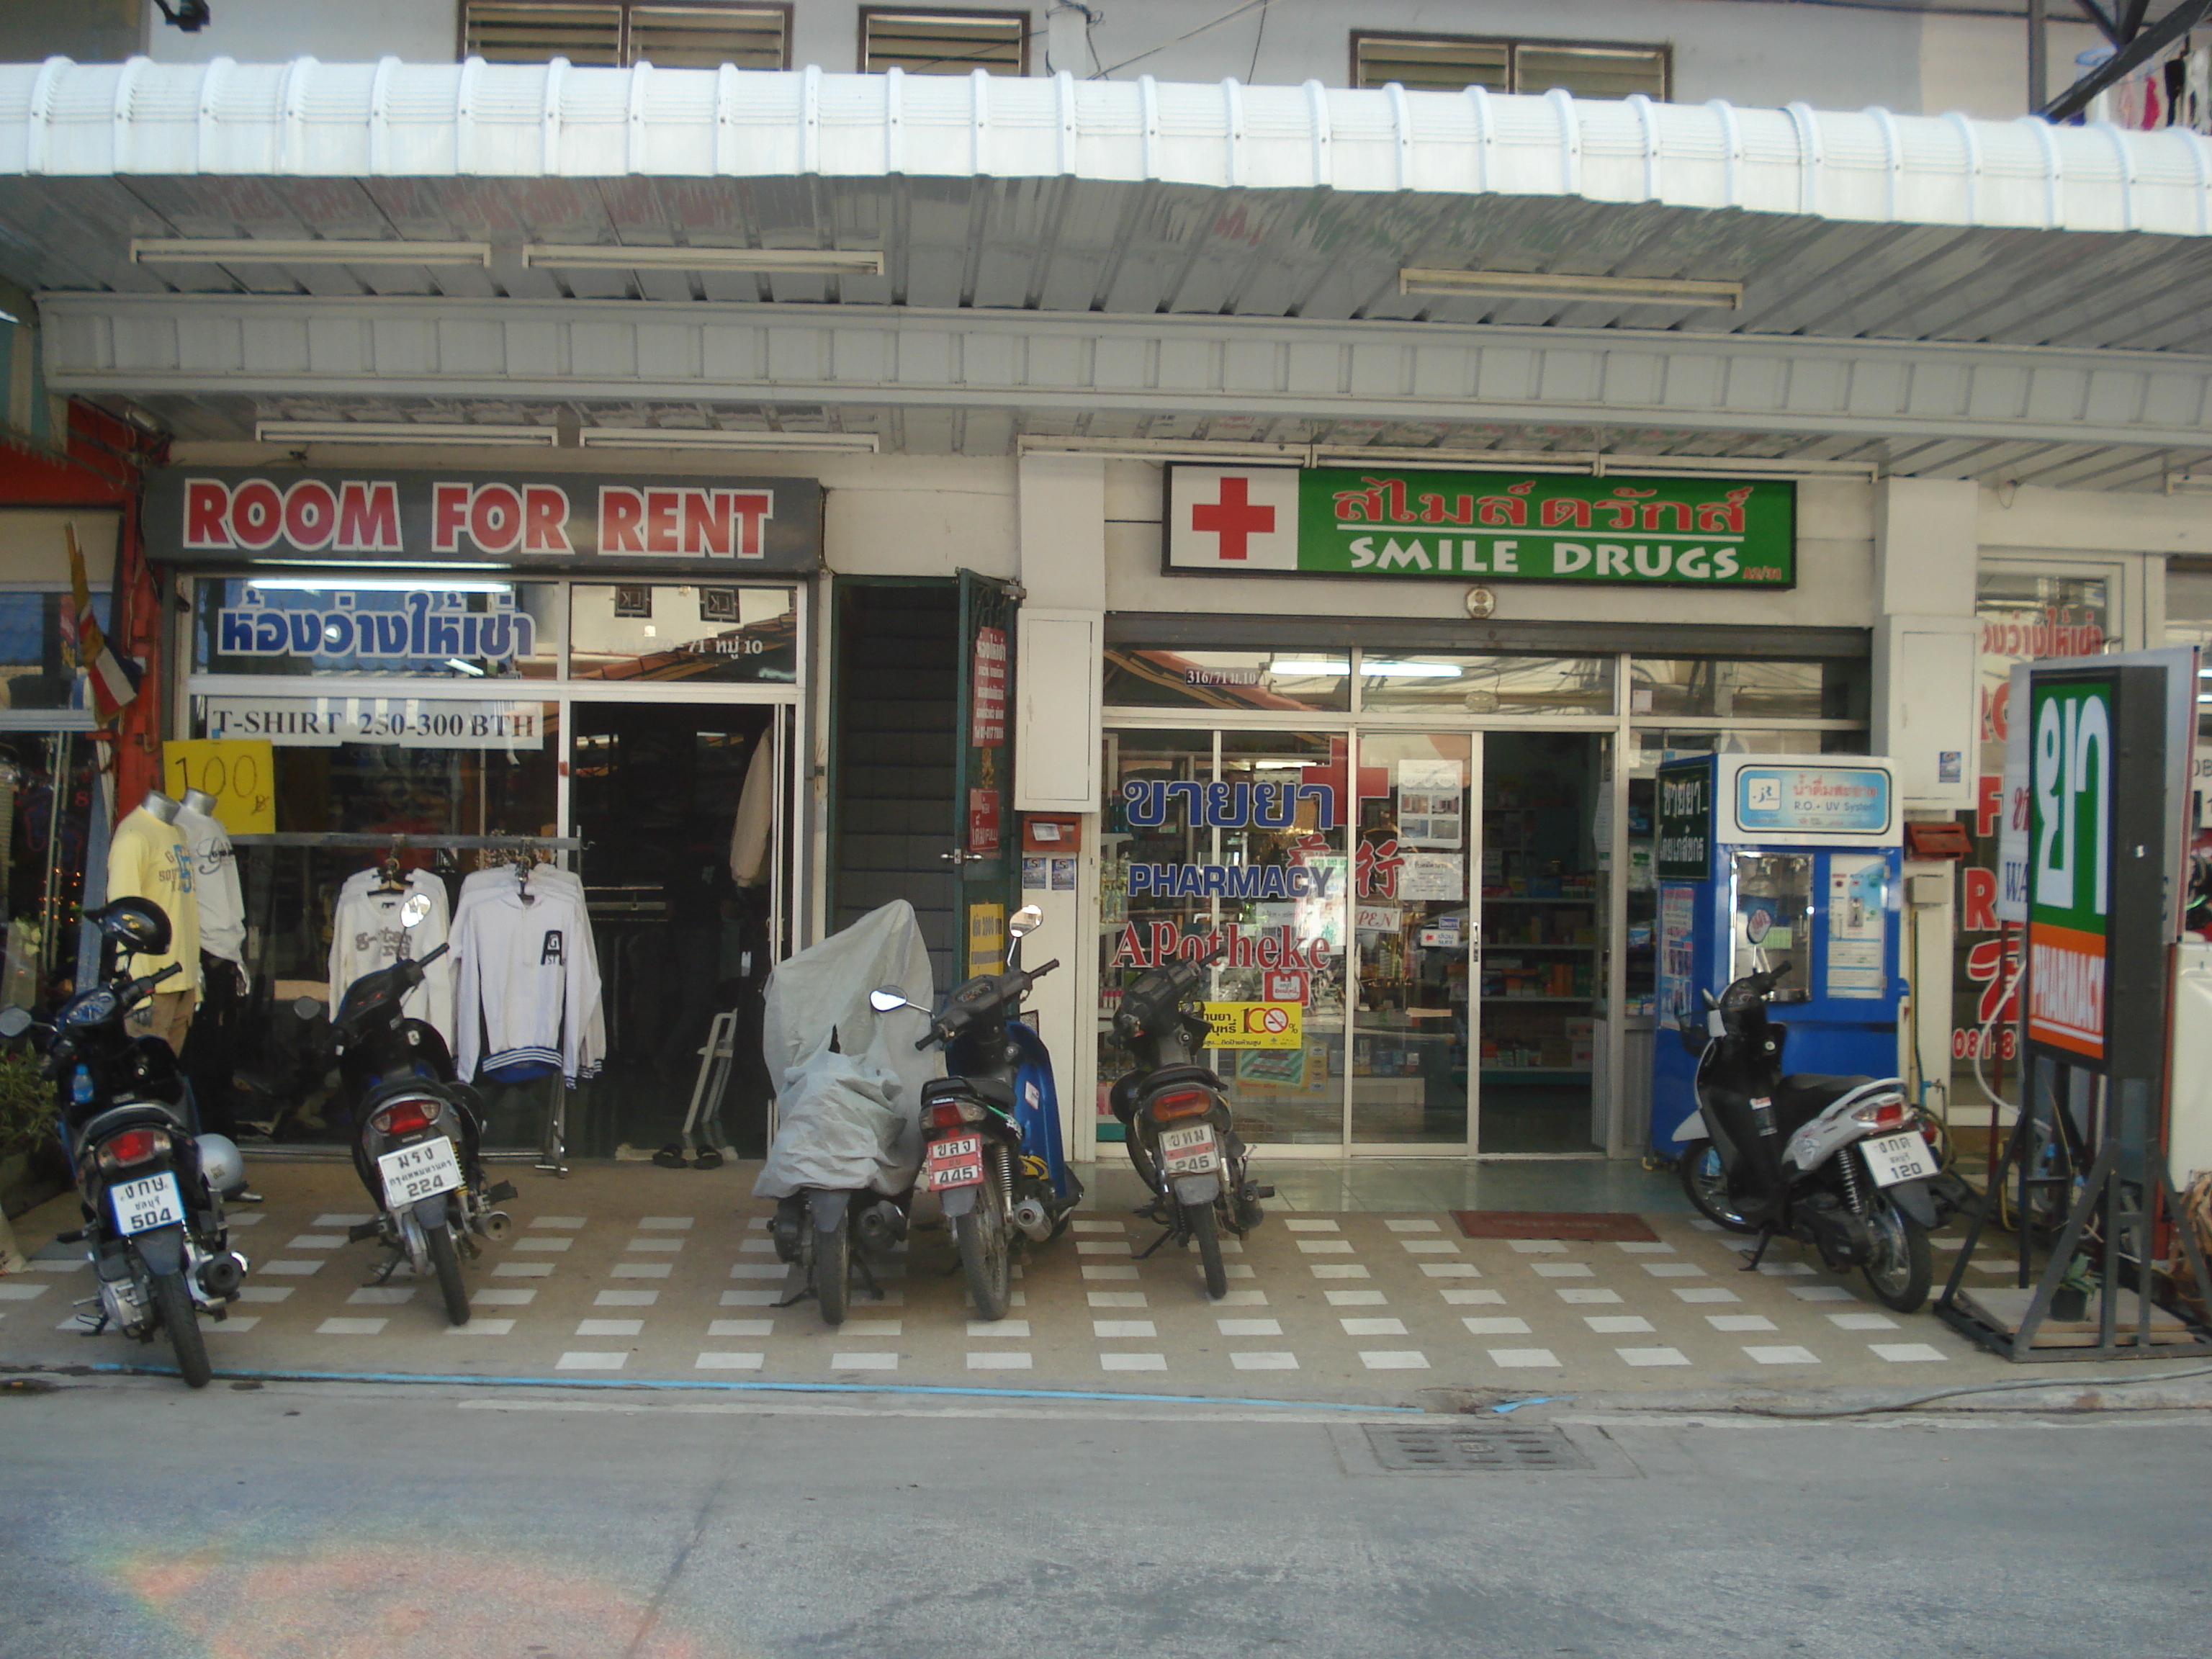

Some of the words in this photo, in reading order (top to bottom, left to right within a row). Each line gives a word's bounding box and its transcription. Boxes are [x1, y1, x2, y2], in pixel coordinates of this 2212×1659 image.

[183, 478, 403, 552] ROOM
[432, 482, 575, 554] FOR
[598, 485, 774, 559] RENT
[1349, 536, 1519, 573] SMILE
[1553, 541, 1740, 579] DRUGS
[217, 586, 536, 658] ห้องว่างให้เช่า
[744, 639, 763, 654] 10
[1187, 670, 1226, 684] 316/71
[213, 709, 342, 735] T-SHIRT
[359, 713, 463, 738] 250-300
[470, 714, 534, 738] BTH
[175, 755, 257, 798] 100
[1123, 781, 1335, 830] ขายยา
[1826, 801, 1840, 811] UV
[2036, 693, 2110, 916] ยา
[1128, 863, 1334, 899] PHARMACY
[1356, 908, 1398, 928] PEN
[2030, 942, 2107, 1033] PHARMACY
[940, 1166, 973, 1184] 445
[1176, 1155, 1210, 1170] 245
[1890, 1162, 1923, 1179] 120
[407, 1174, 444, 1197] 224
[130, 1207, 172, 1230] 504
